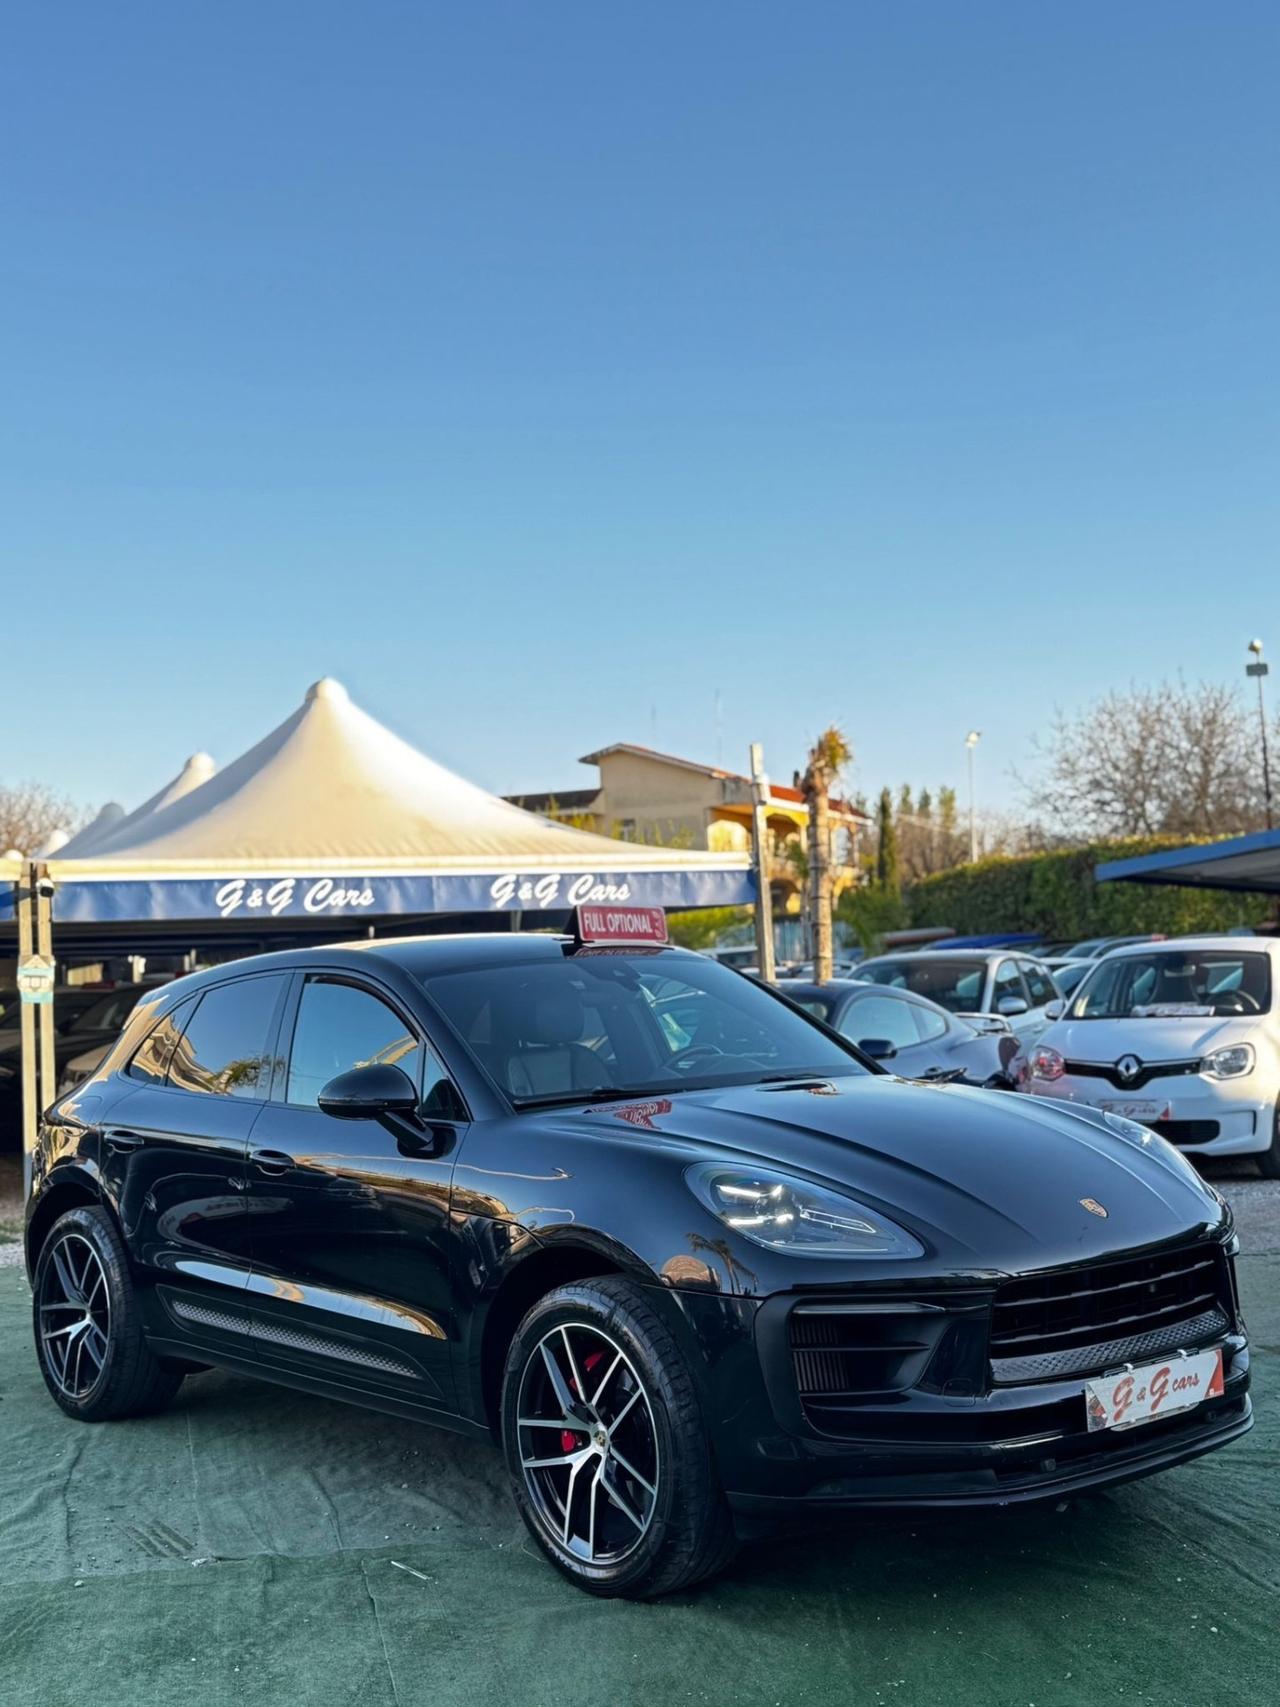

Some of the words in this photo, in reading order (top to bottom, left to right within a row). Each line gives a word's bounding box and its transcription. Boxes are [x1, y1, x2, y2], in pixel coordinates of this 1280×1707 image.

[303, 878, 375, 913] Cars
[567, 873, 631, 906] Cars
[583, 912, 605, 933] FULL
[606, 912, 653, 934] OPTIONAL
[1172, 1372, 1200, 1393] cars
